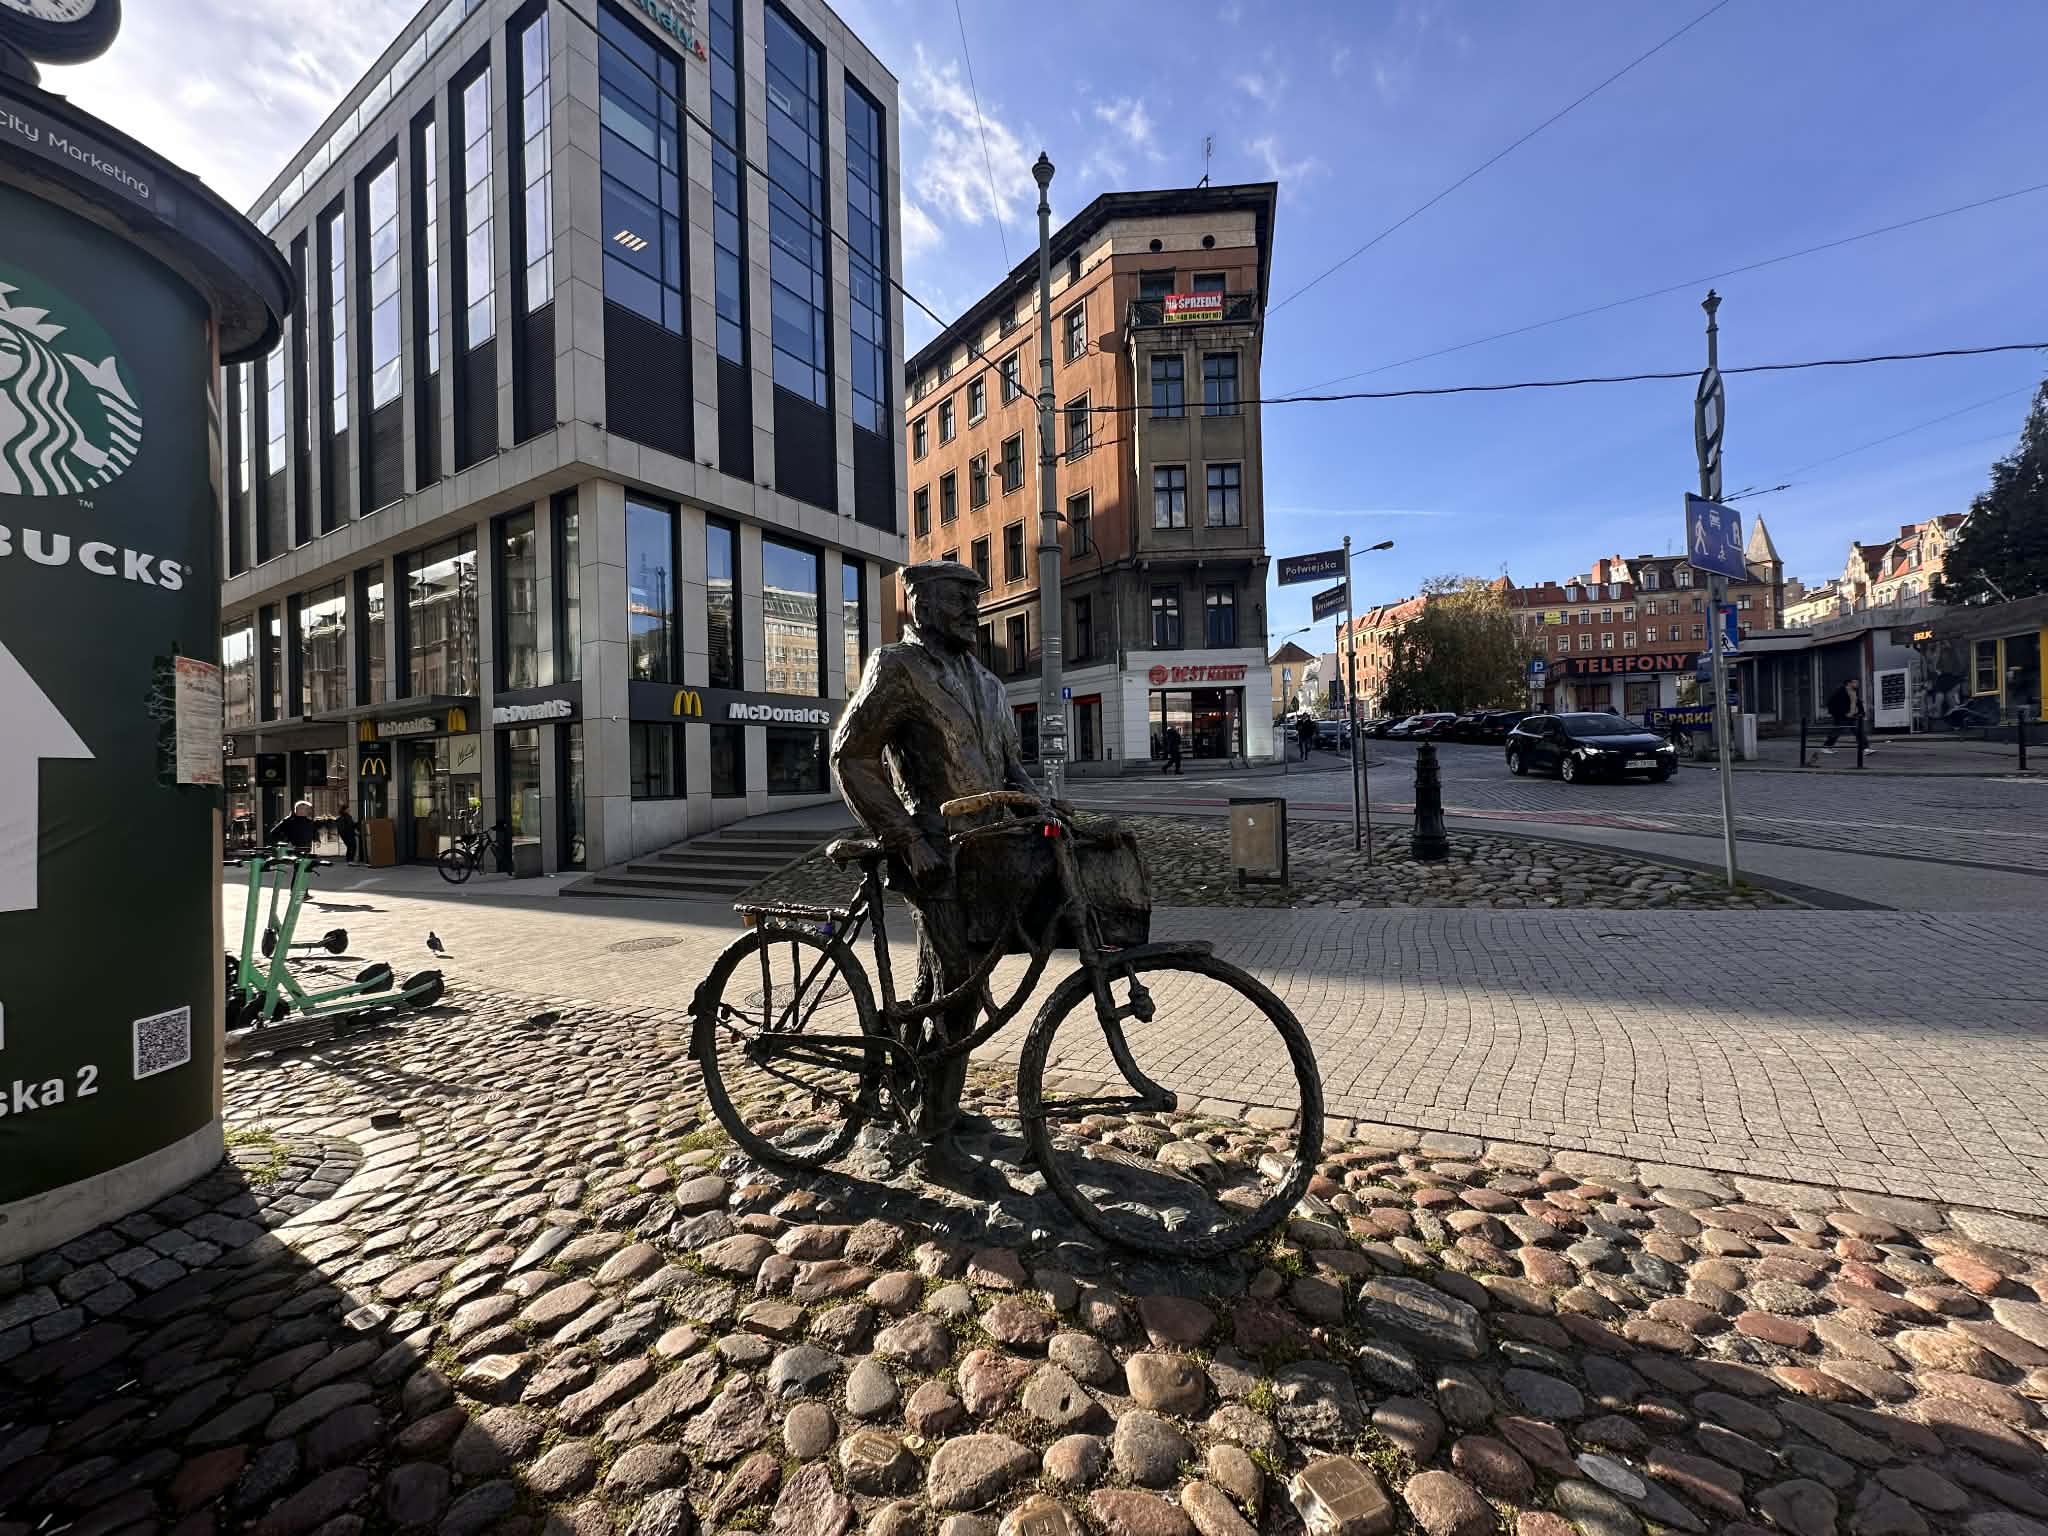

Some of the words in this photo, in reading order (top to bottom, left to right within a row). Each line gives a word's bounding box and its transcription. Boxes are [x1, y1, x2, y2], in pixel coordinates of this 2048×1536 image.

[49, 132, 149, 198] Marketing
[1575, 655, 1687, 673] TELEFONY
[729, 703, 830, 724] McDonald's
[377, 717, 436, 737] McDonald's
[76, 1064, 98, 1098] 2
